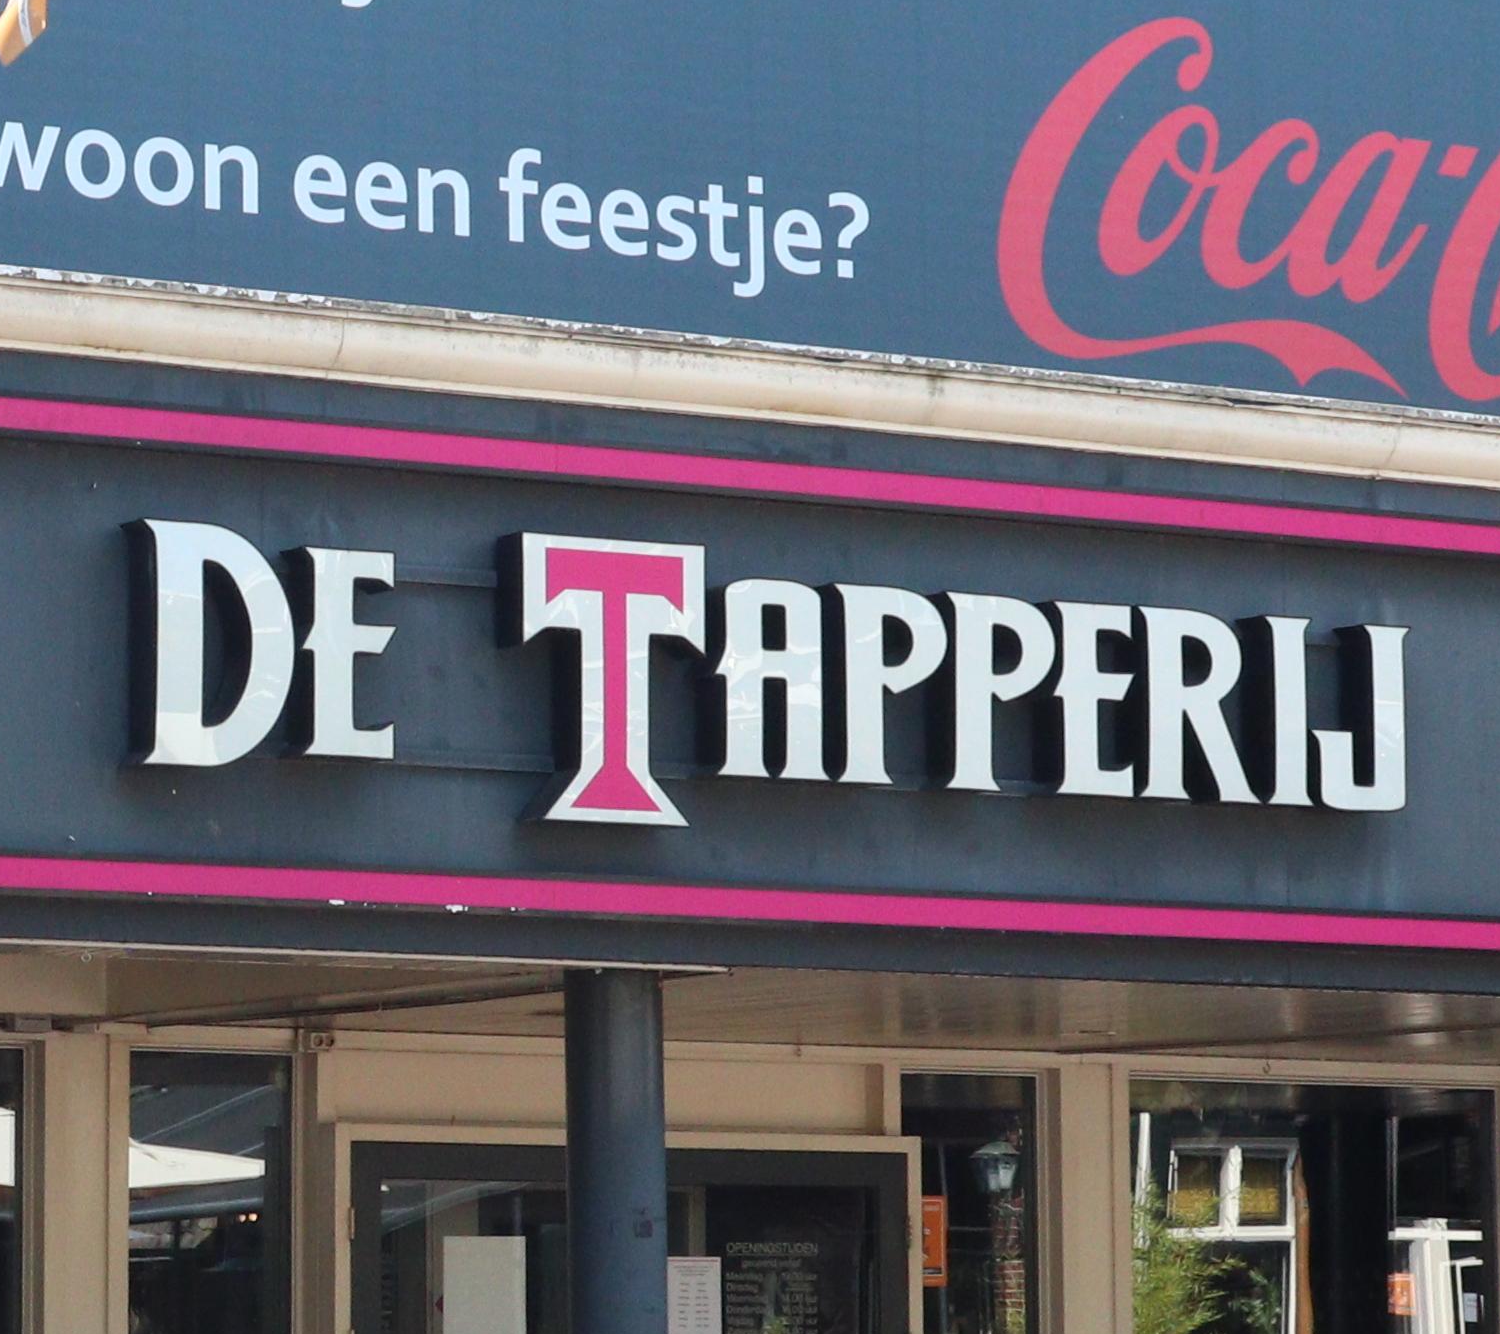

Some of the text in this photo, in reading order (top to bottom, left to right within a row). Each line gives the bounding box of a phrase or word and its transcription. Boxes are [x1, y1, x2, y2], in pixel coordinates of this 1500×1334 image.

[294, 153, 470, 237] een
[499, 147, 870, 299] feestje?
[143, 519, 1409, 827] DE TAPPERIJ
